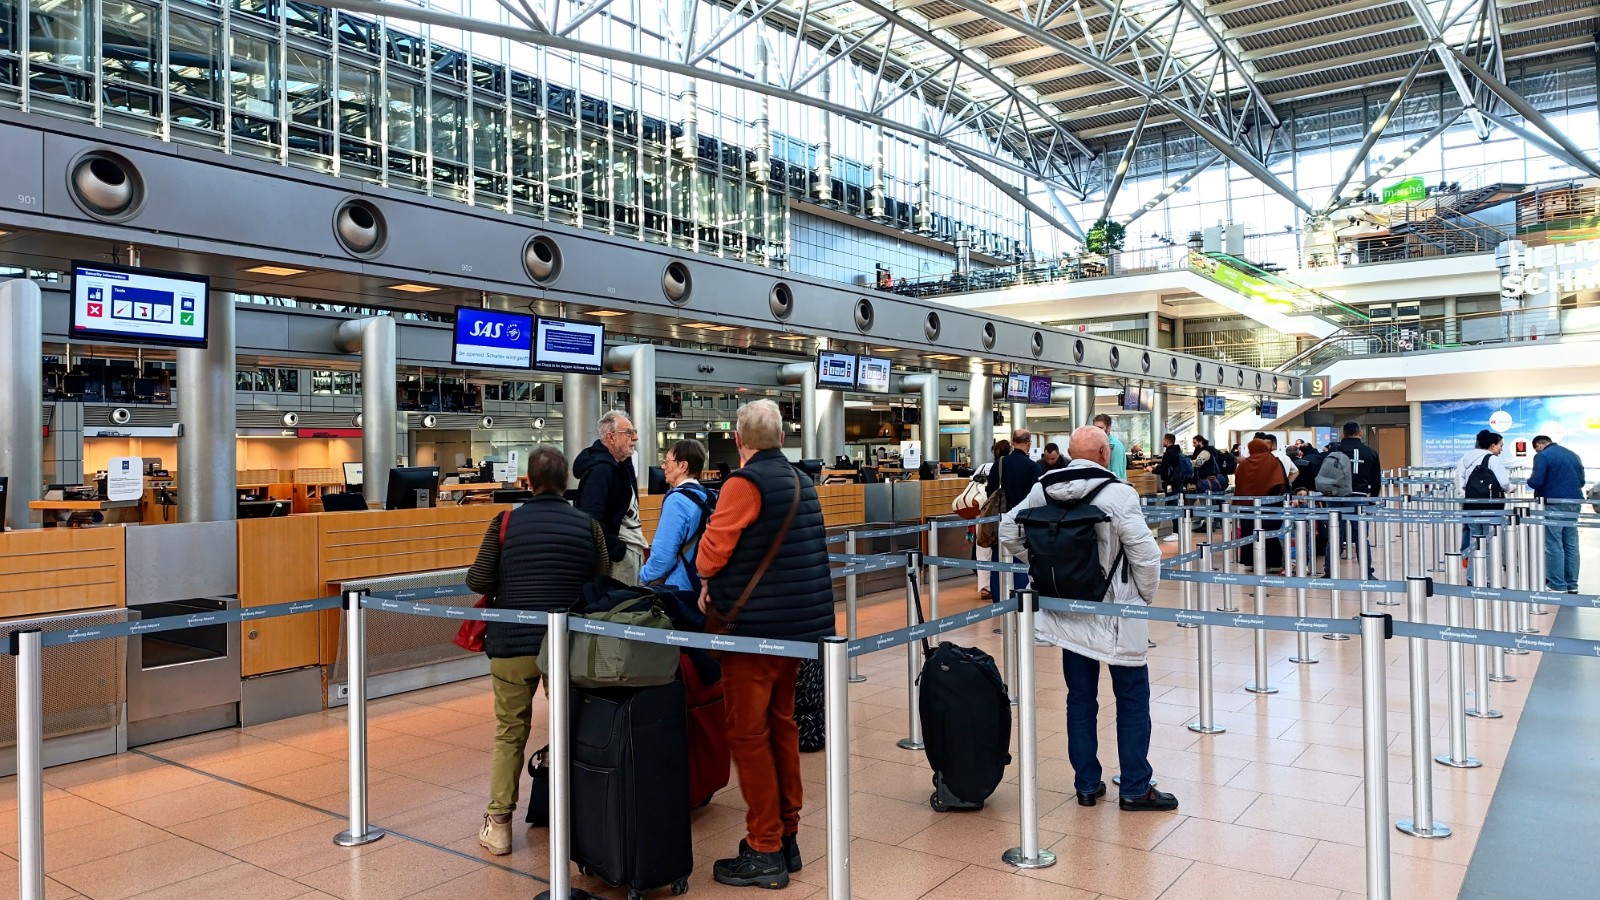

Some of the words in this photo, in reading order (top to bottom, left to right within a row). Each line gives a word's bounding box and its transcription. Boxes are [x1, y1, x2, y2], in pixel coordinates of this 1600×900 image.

[1384, 184, 1422, 198] marché
[18, 194, 36, 205] 901
[461, 263, 473, 272] 902
[85, 270, 102, 278] Security
[469, 320, 504, 338] SAS
[1312, 378, 1323, 392] 9
[1440, 630, 1461, 638] Hamburg
[1515, 638, 1537, 646] Hamburg
